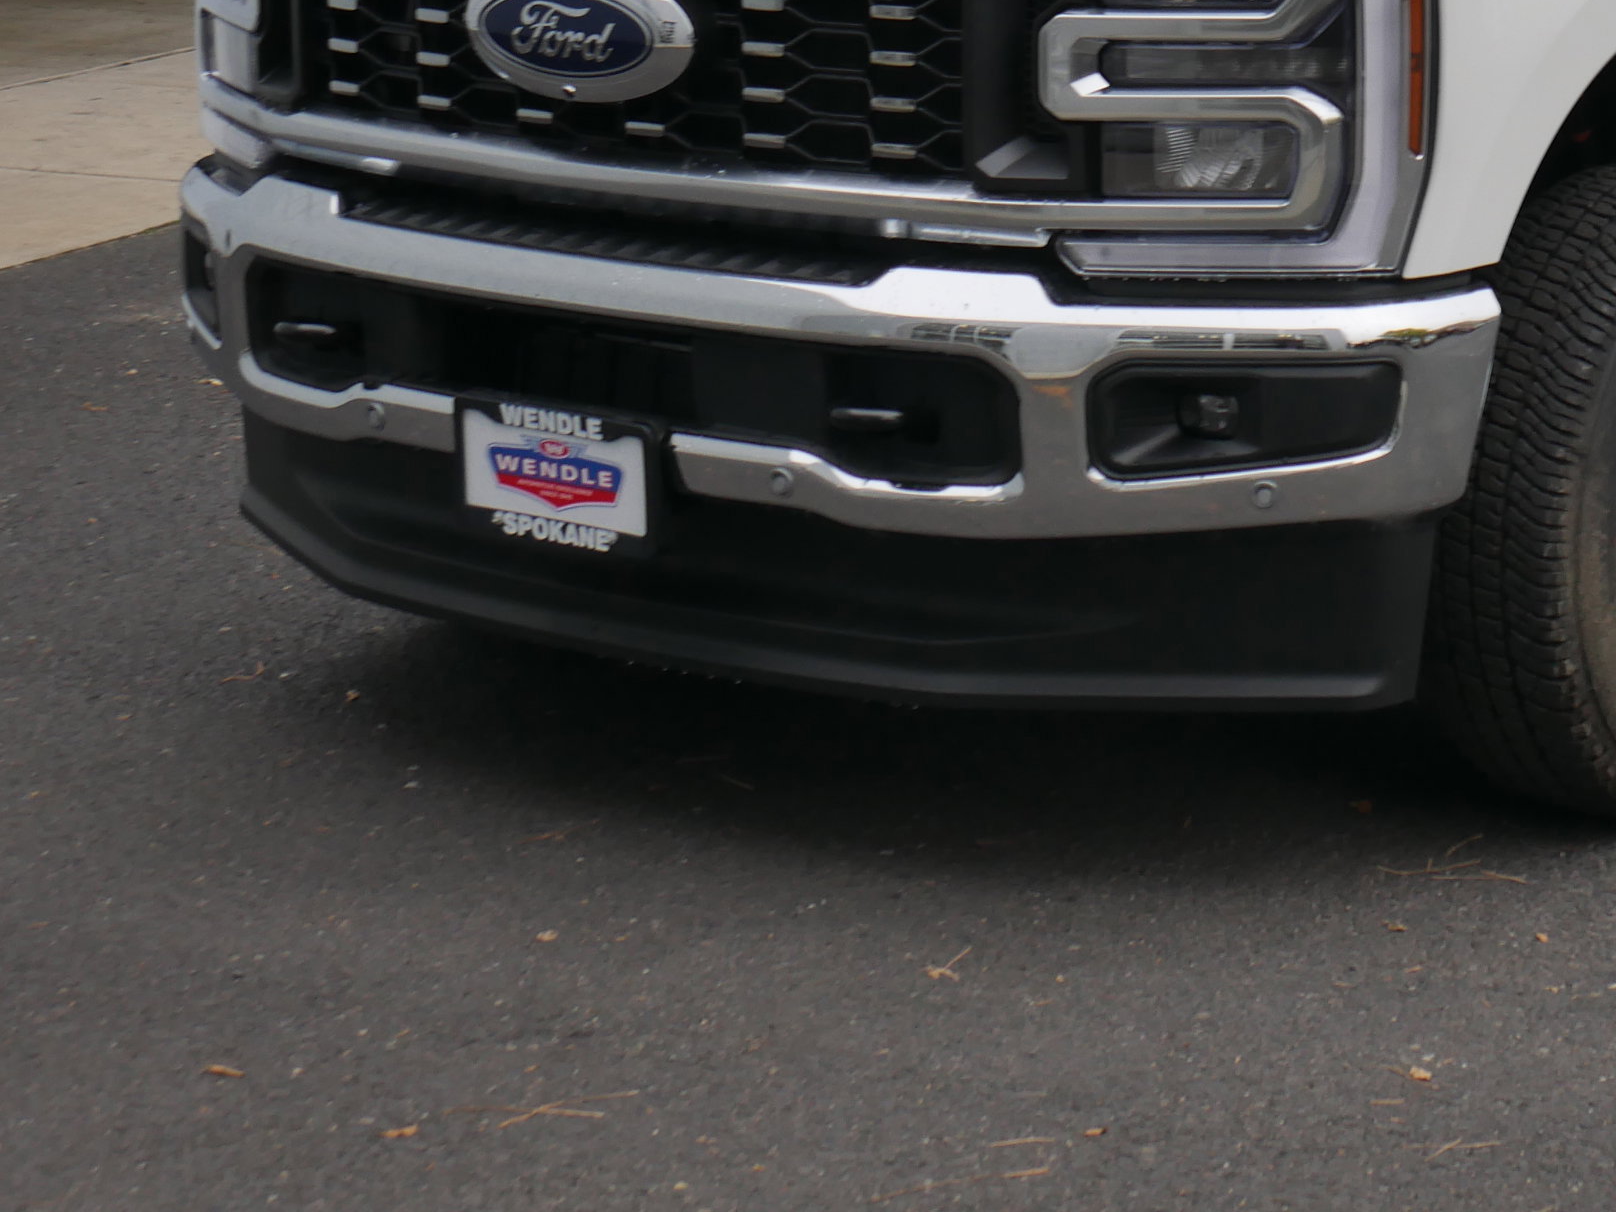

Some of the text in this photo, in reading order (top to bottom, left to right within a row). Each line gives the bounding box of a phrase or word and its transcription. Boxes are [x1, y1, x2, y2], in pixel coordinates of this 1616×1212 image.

[510, 0, 617, 63] Ford
[499, 403, 603, 440] WENDLE
[495, 453, 613, 488] WENDLE
